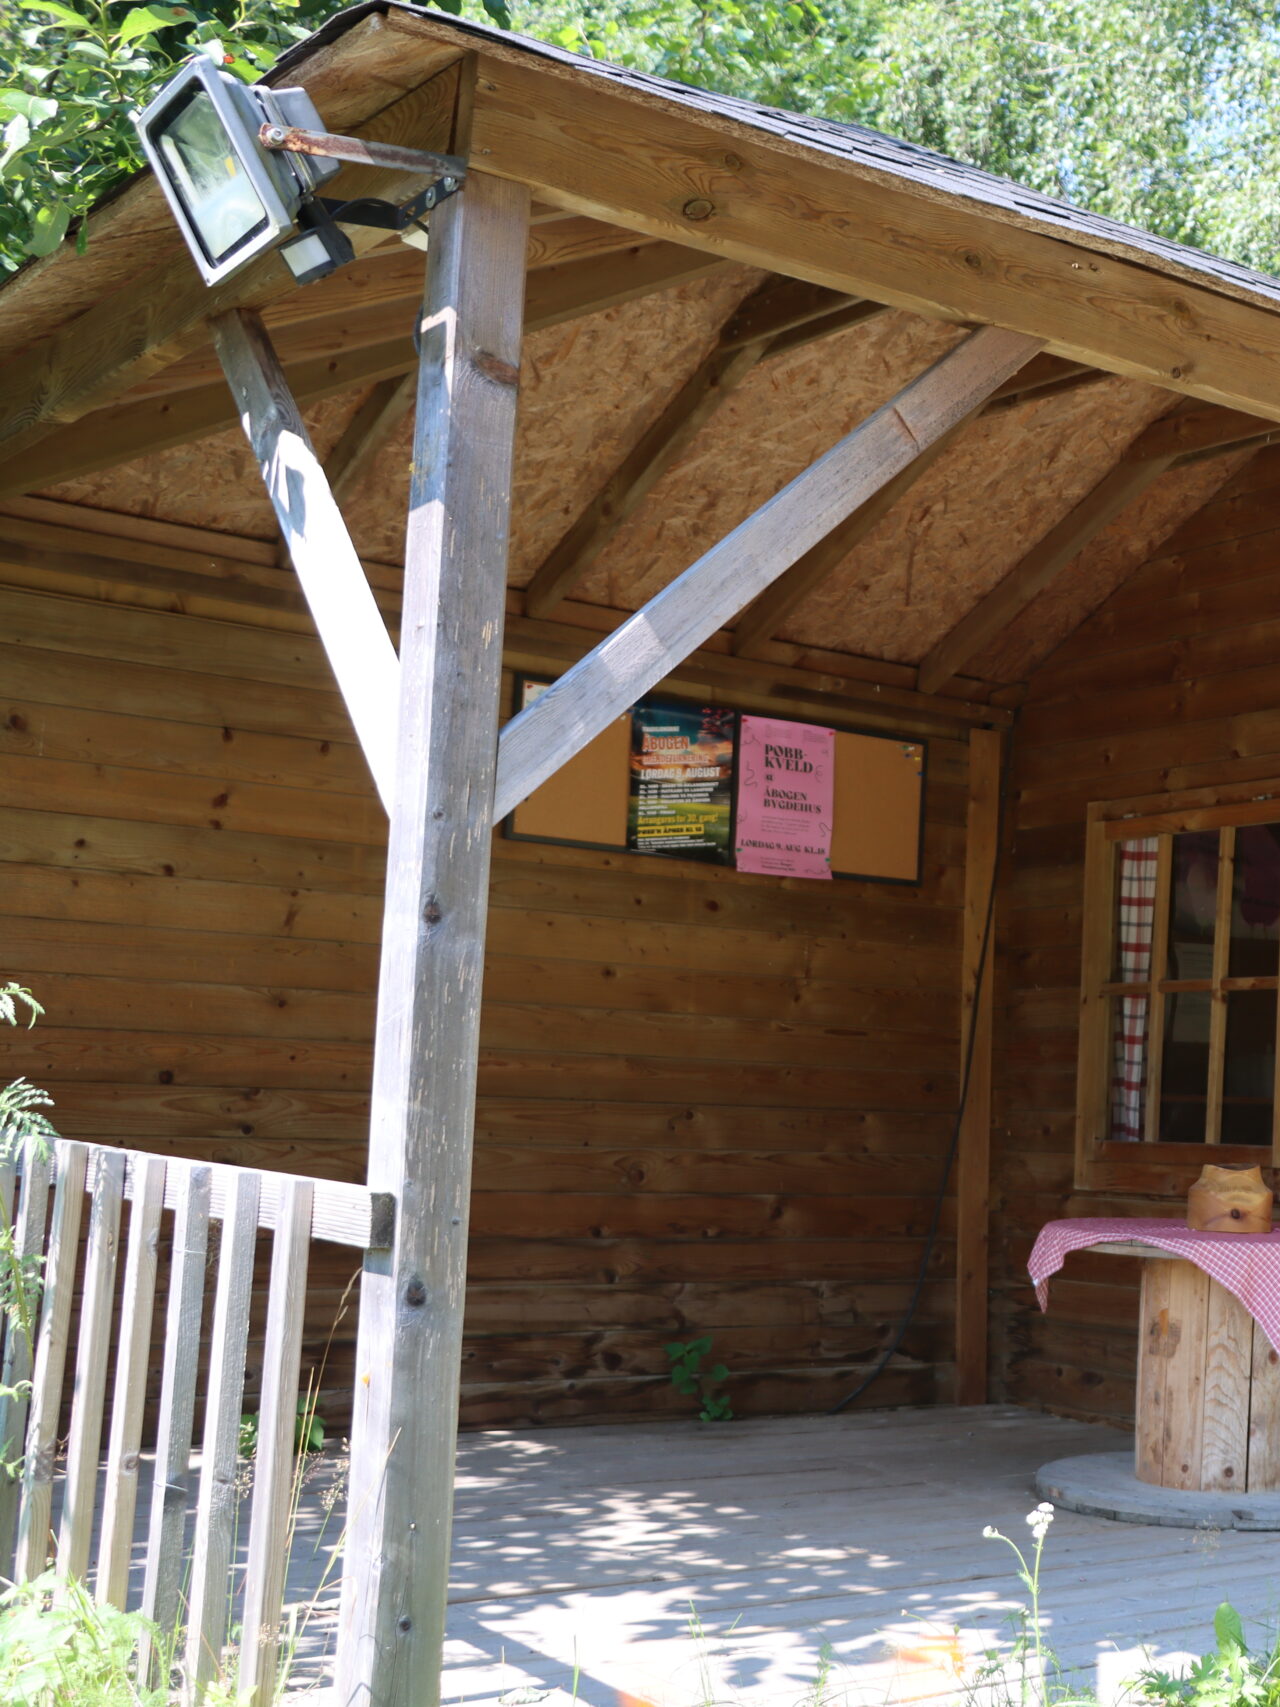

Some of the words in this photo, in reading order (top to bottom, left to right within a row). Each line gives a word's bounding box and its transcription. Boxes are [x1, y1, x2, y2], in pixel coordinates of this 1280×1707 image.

[685, 765, 720, 778] AUGUST
[765, 756, 814, 773] KVELD
[764, 798, 821, 814] BYGDEHUS
